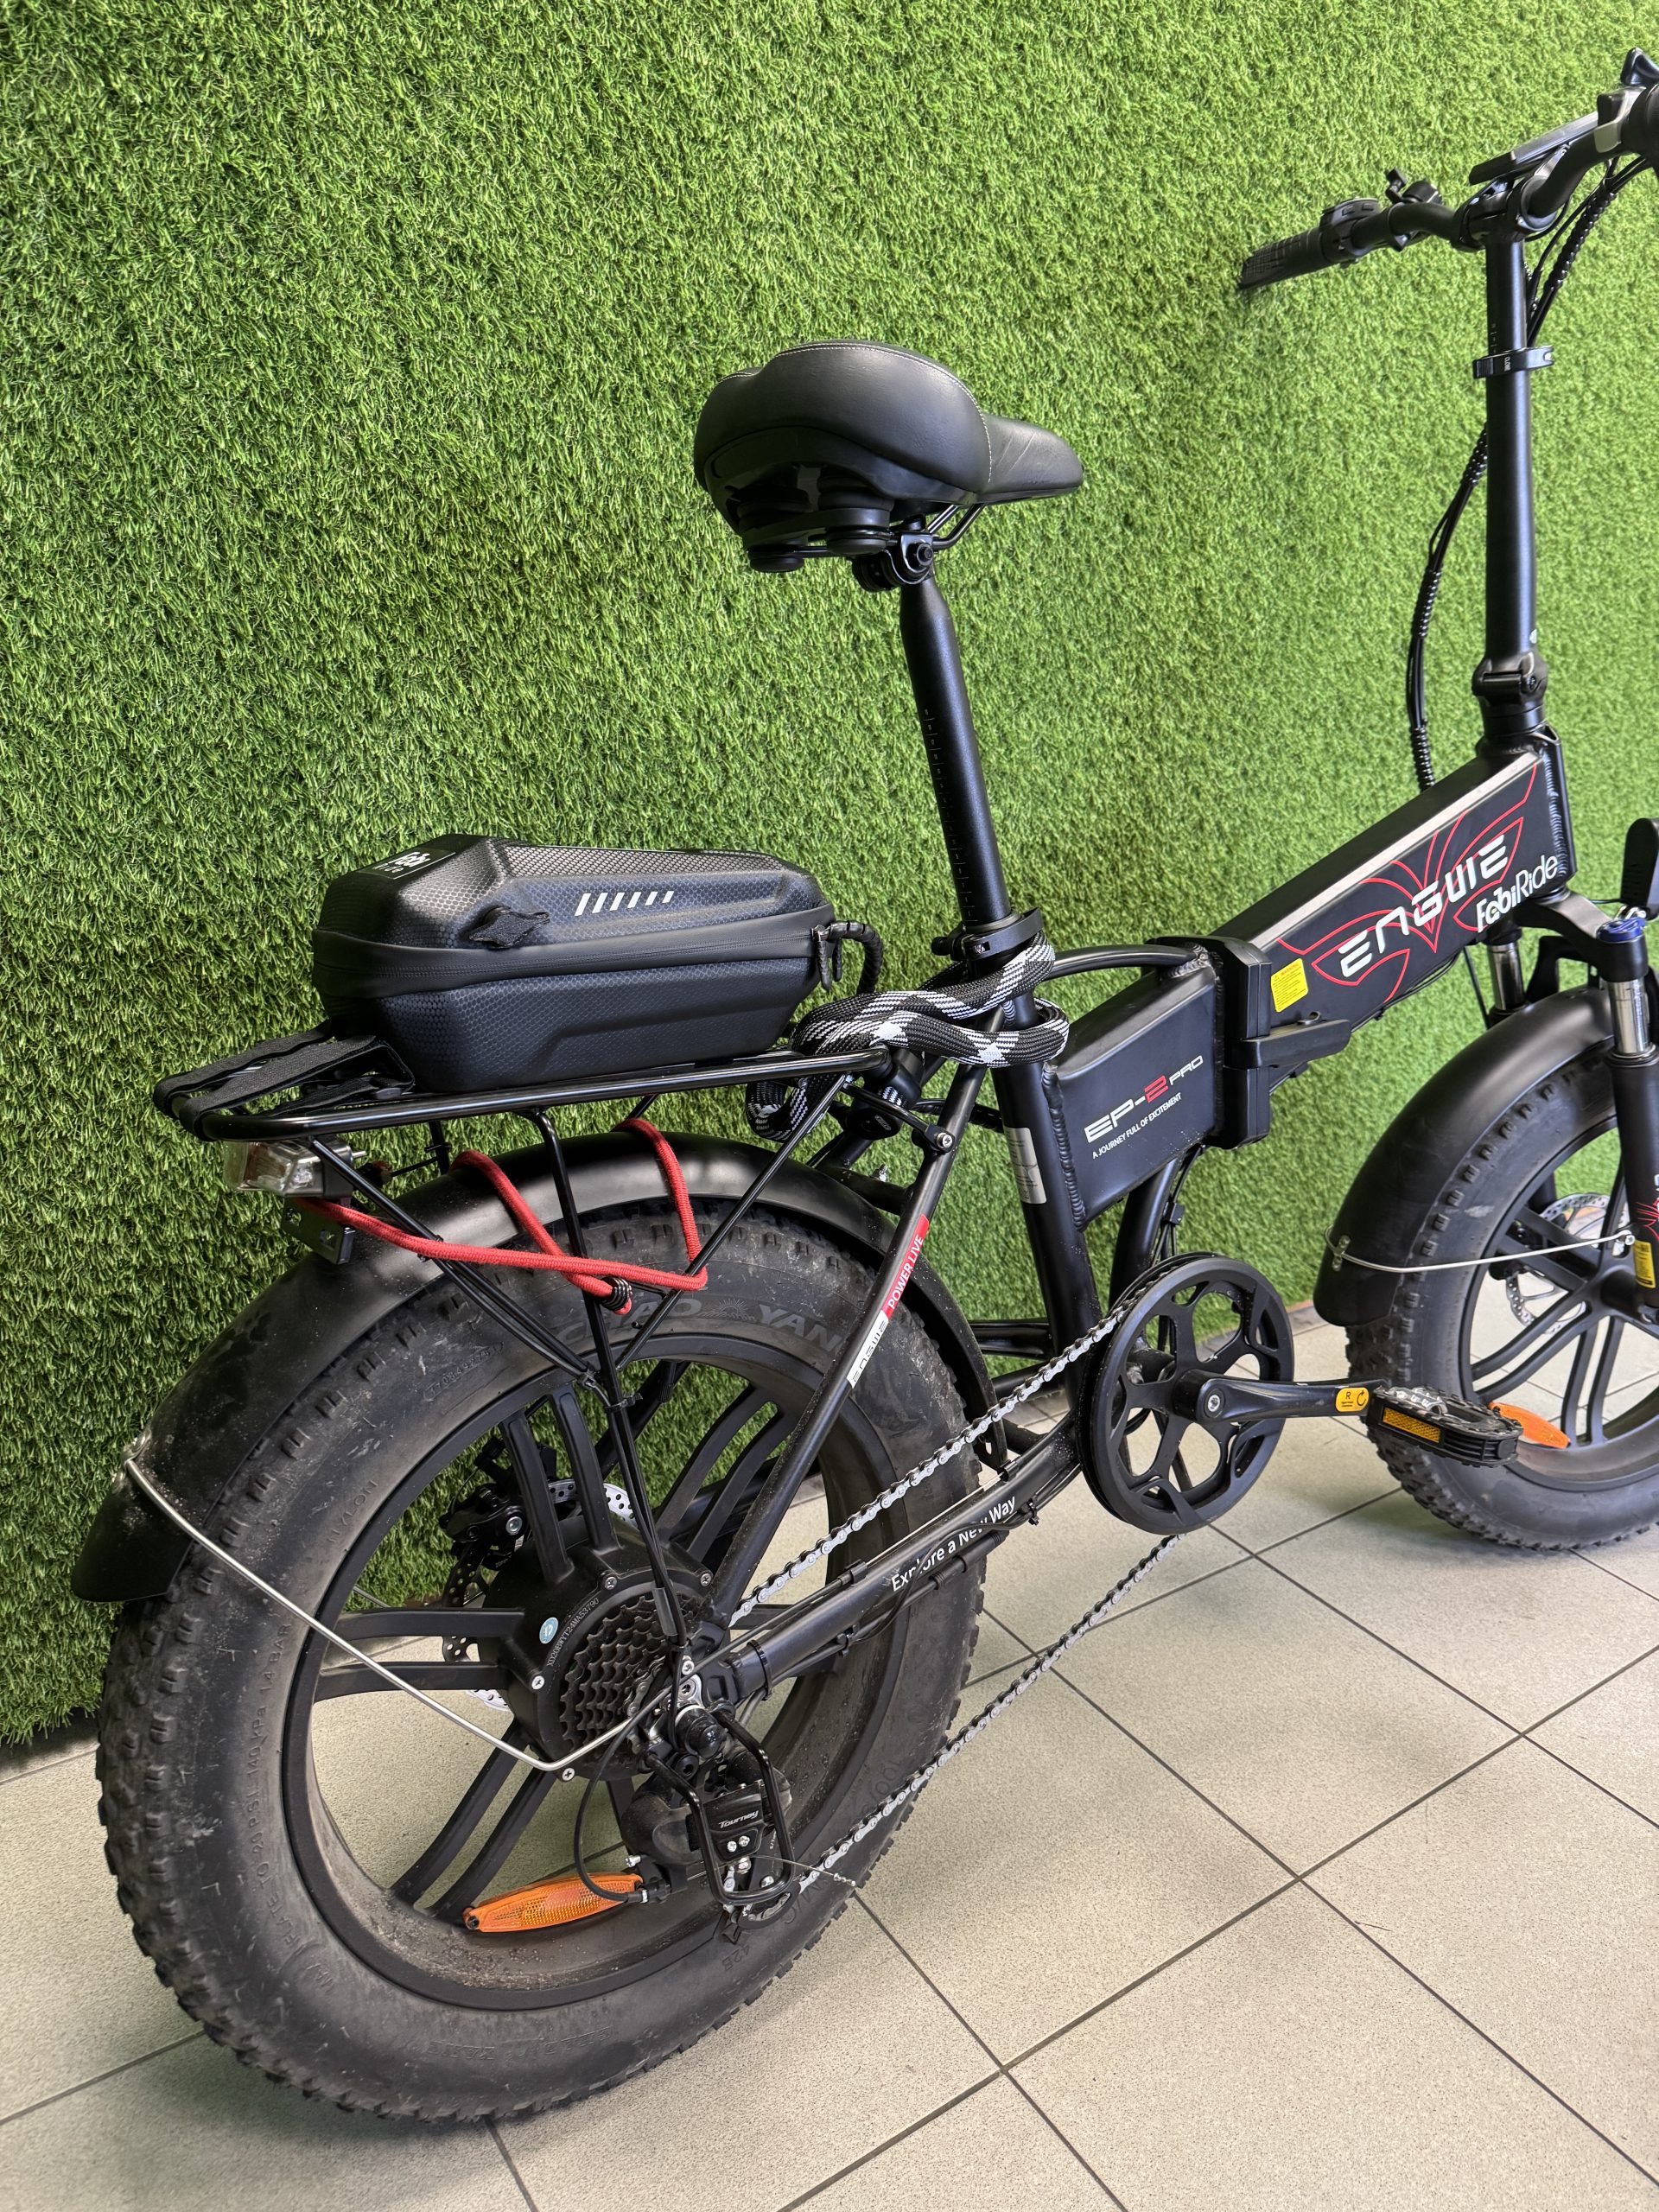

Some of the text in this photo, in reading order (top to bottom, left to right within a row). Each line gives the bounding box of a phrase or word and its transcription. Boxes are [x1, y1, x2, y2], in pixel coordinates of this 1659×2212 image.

[1084, 1055, 1204, 1143] EP-2 PRO
[1092, 1091, 1182, 1160] A JOURNEY FULL OF EXCITEMENT
[887, 1262, 913, 1310] POWER
[908, 1234, 924, 1264] LIVE
[556, 1298, 702, 1345] CAO
[1345, 1391, 1351, 1400] R
[948, 1544, 957, 1554] a
[988, 1497, 1016, 1523] Way
[266, 1623, 292, 1663] BAR
[718, 1809, 760, 1829] Tourney
